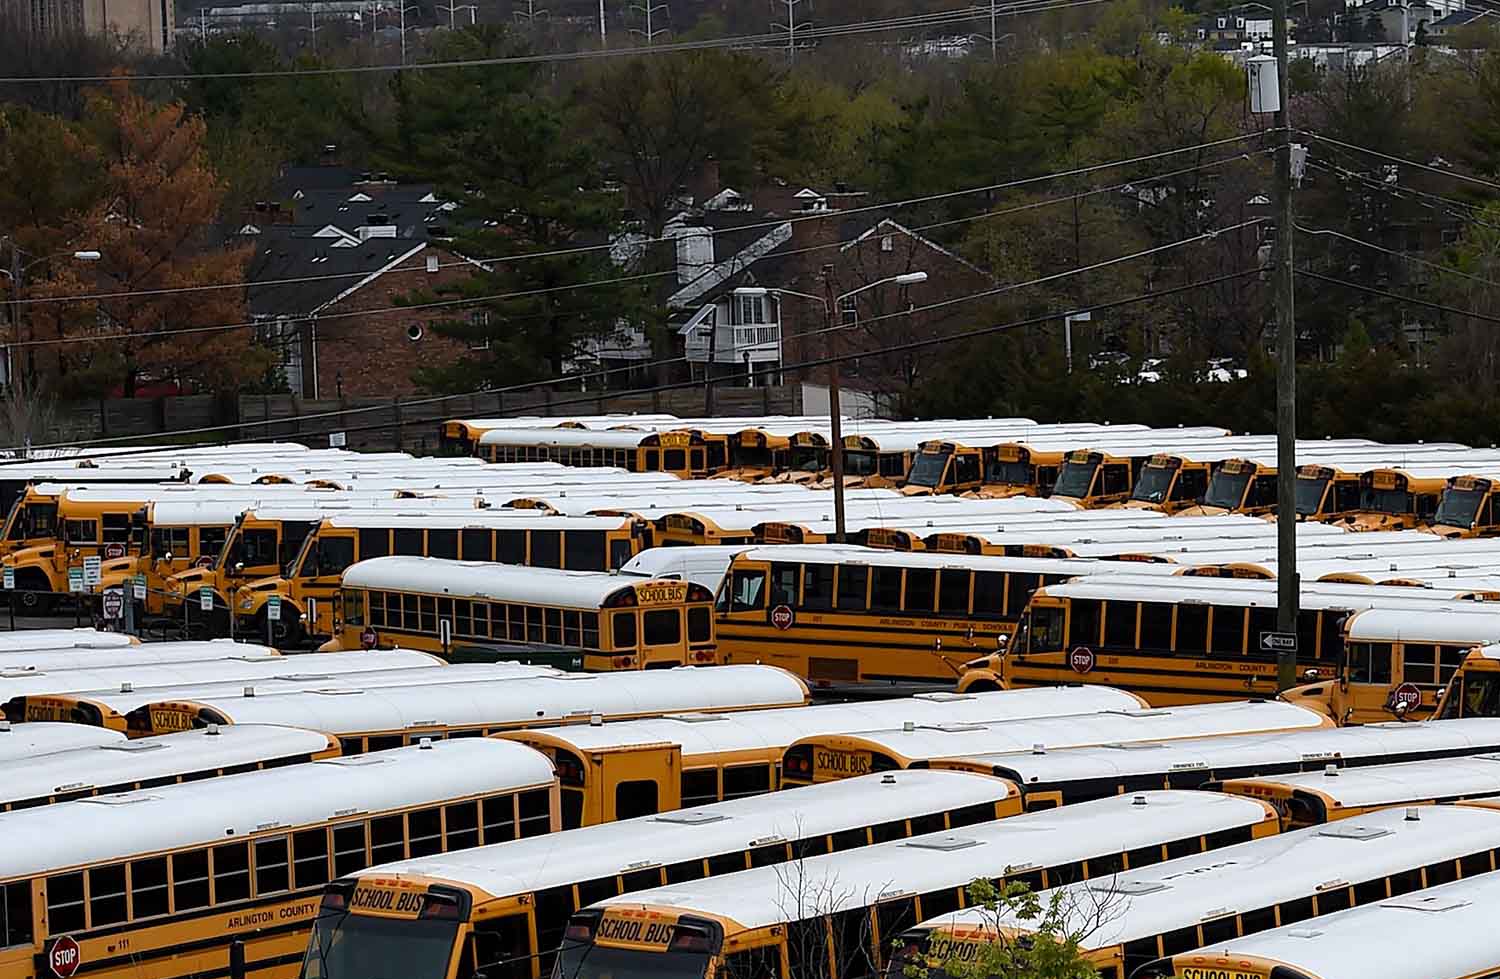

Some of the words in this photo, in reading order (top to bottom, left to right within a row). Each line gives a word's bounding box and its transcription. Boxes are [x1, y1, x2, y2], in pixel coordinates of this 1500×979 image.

[639, 589, 664, 601] SCHOOL
[666, 587, 682, 600] BUS
[774, 611, 790, 622] STOP
[1073, 654, 1091, 665] STOP
[1398, 692, 1418, 704] STOP
[155, 711, 181, 728] SCHOOL
[818, 751, 848, 770] SCHOOL
[849, 755, 868, 773] BUS
[352, 887, 394, 909] SCHOOL
[396, 892, 423, 912] BUS
[228, 911, 274, 929] ARLINGTON
[279, 903, 316, 920] COUNTY
[600, 917, 642, 941] SCHOOL
[645, 922, 674, 944] BUS
[55, 949, 76, 965] STOP
